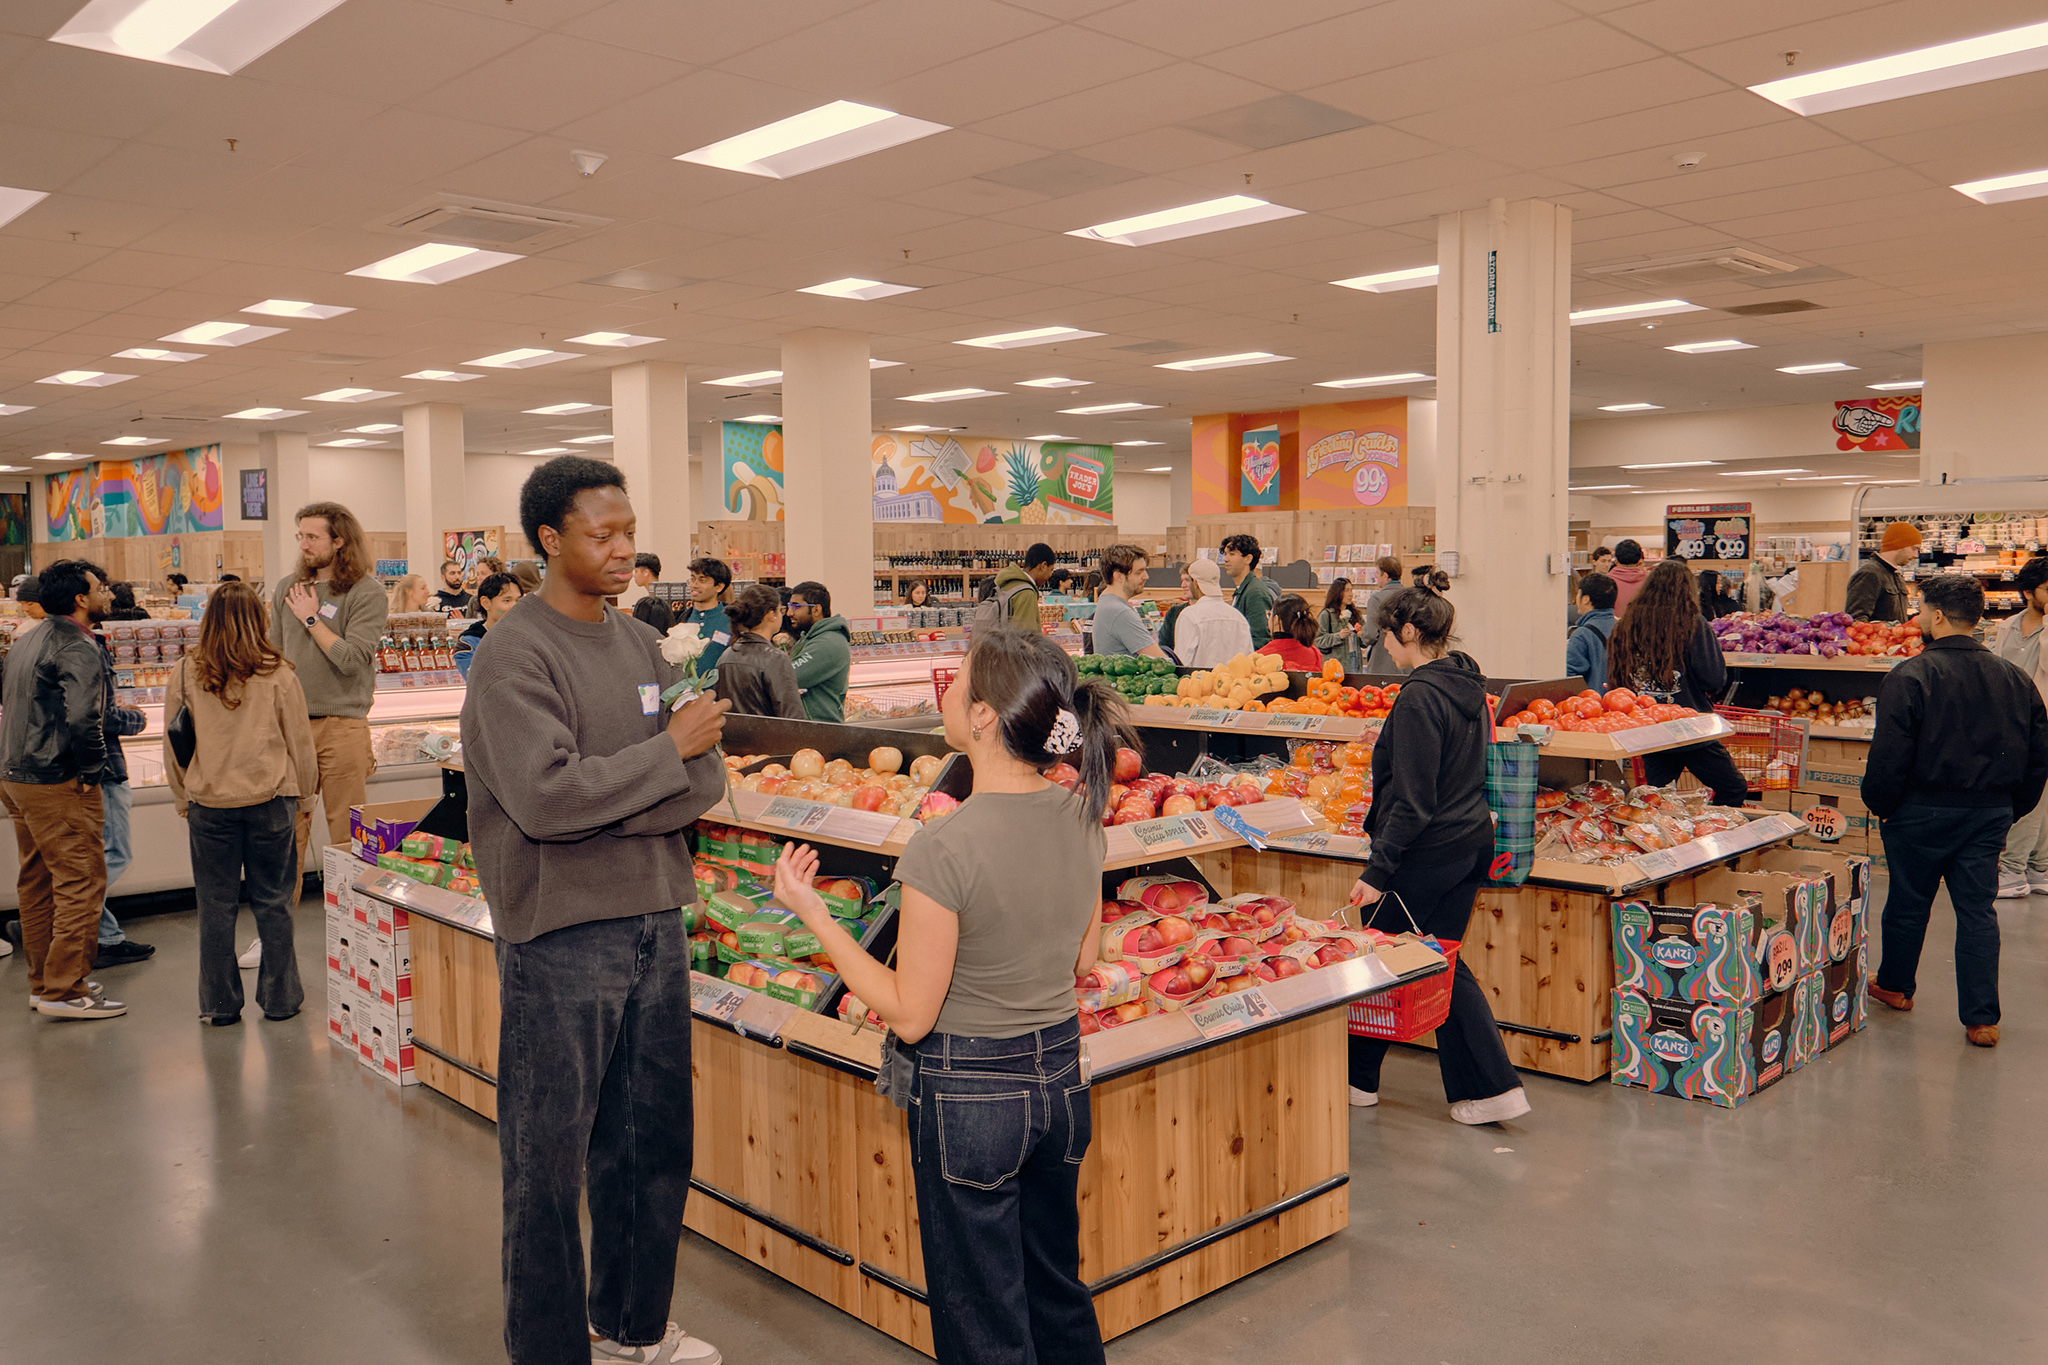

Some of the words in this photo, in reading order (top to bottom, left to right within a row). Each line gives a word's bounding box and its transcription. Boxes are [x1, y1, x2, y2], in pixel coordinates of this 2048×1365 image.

[1488, 256, 1496, 289] STORM
[1488, 290, 1496, 320] DRAIN
[1894, 405, 1921, 434] R
[1307, 434, 1354, 473] Greeting
[1354, 434, 1397, 461] Cards
[1070, 471, 1097, 486] TRADER
[1072, 481, 1093, 493] JOE'S
[1672, 505, 1711, 513] FEARLESS
[1813, 772, 1860, 785] PEPPERS
[769, 808, 799, 819] APPLES
[1807, 812, 1835, 824] Garlic
[1134, 822, 1164, 838] Cosmic
[1143, 832, 1166, 846] Crisp
[1773, 940, 1788, 960] BASIL
[1194, 1008, 1225, 1027] Cosmic
[1222, 1002, 1246, 1016] Crisp
